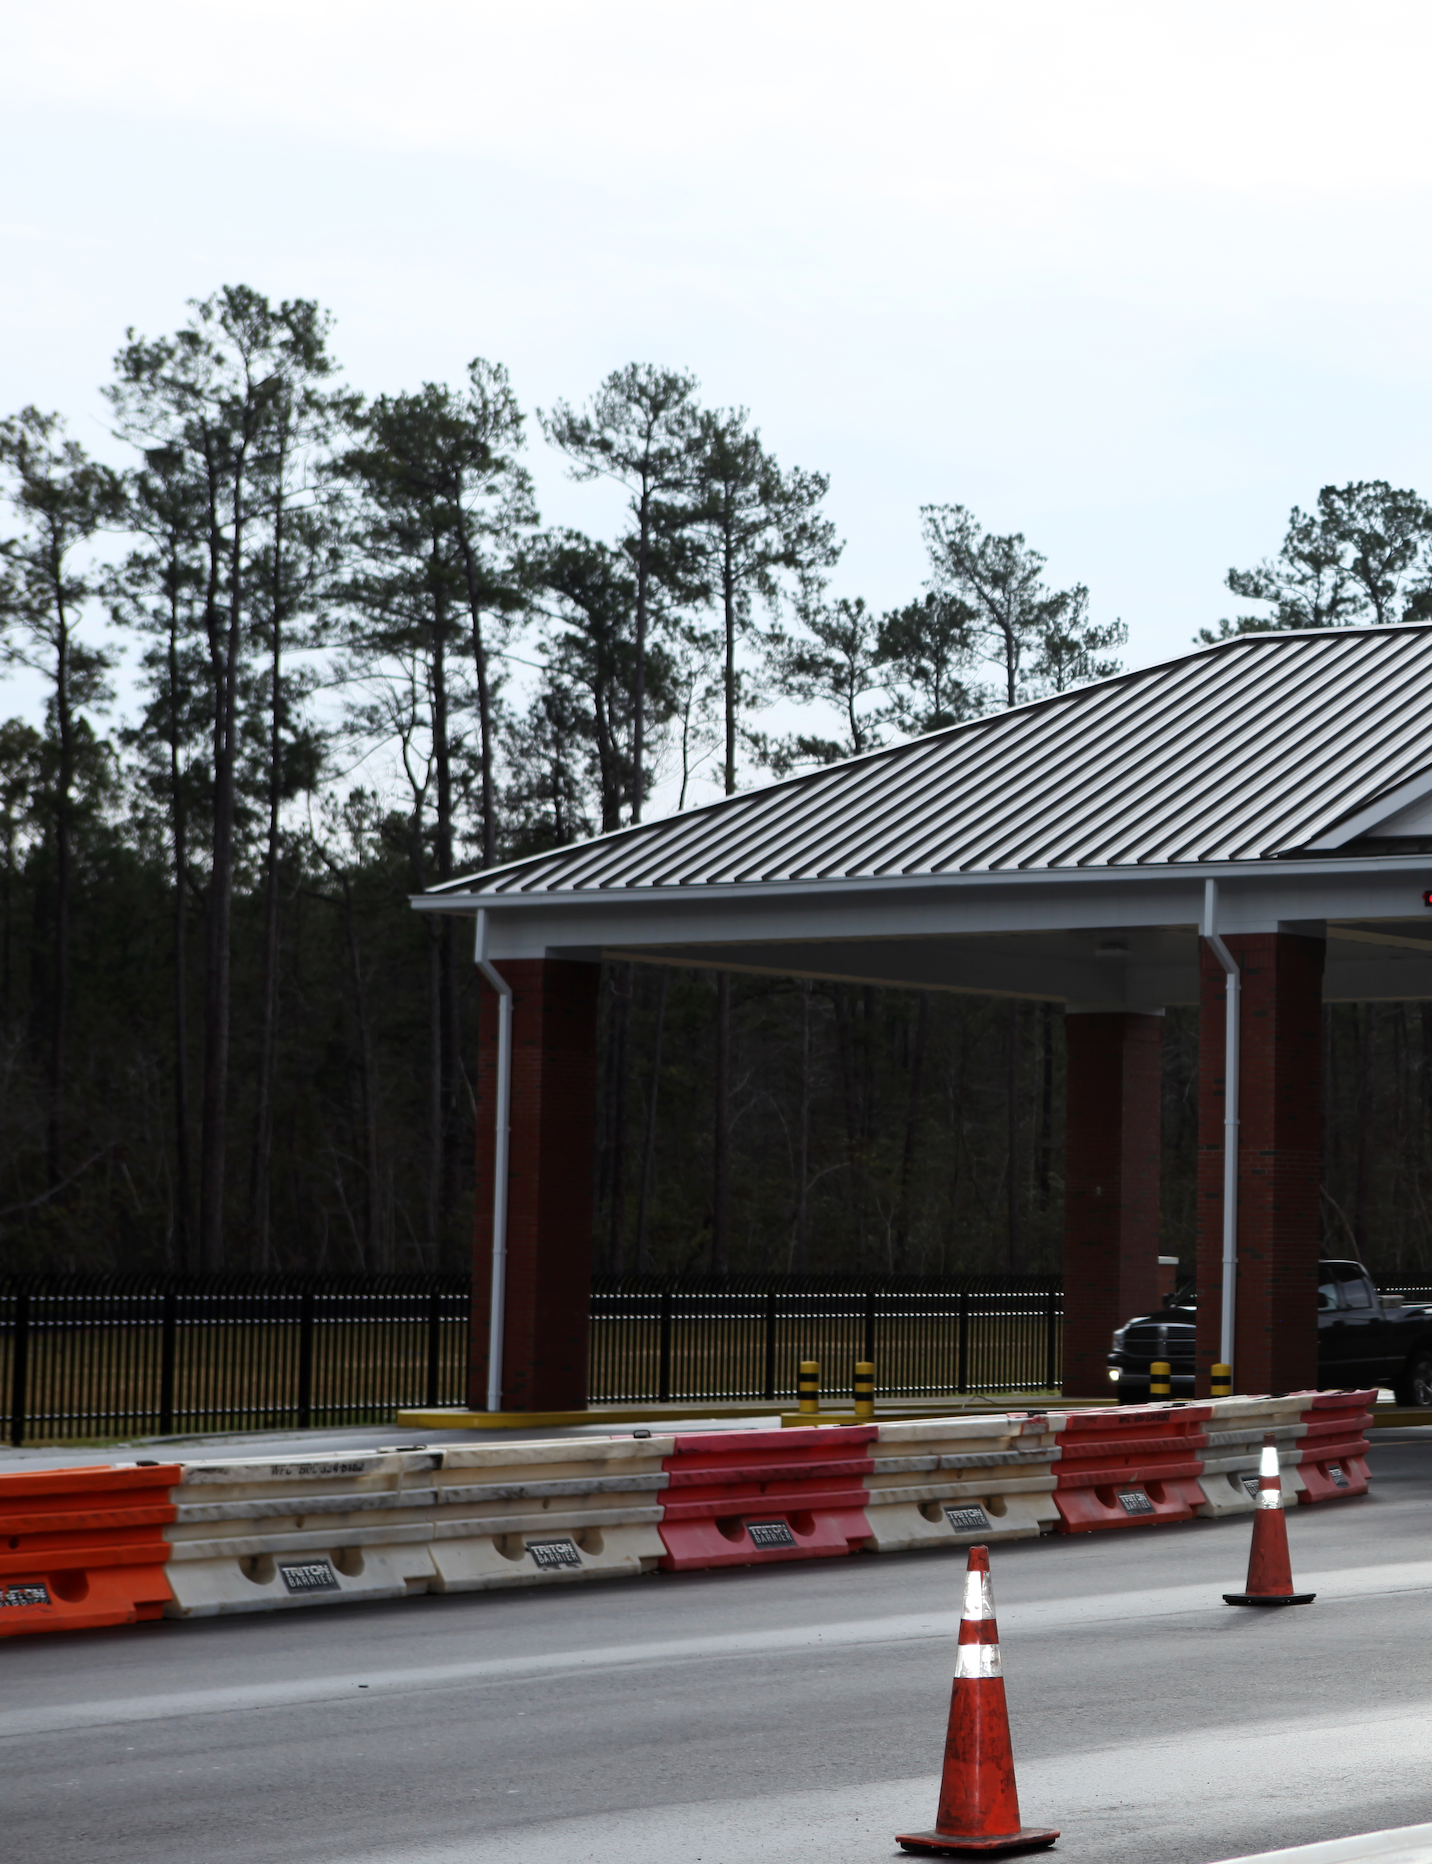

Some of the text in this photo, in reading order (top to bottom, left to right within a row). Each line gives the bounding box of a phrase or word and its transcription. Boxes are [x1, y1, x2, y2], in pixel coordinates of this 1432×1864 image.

[947, 1508, 983, 1519] TRITON
[952, 1517, 988, 1527] BARRIER
[748, 1524, 788, 1535] TRITON
[754, 1532, 793, 1543] BARRIER
[531, 1542, 574, 1555] TRITON
[537, 1552, 579, 1564] BARRIER
[282, 1564, 331, 1577] TRITON
[288, 1574, 335, 1588] BARRIER
